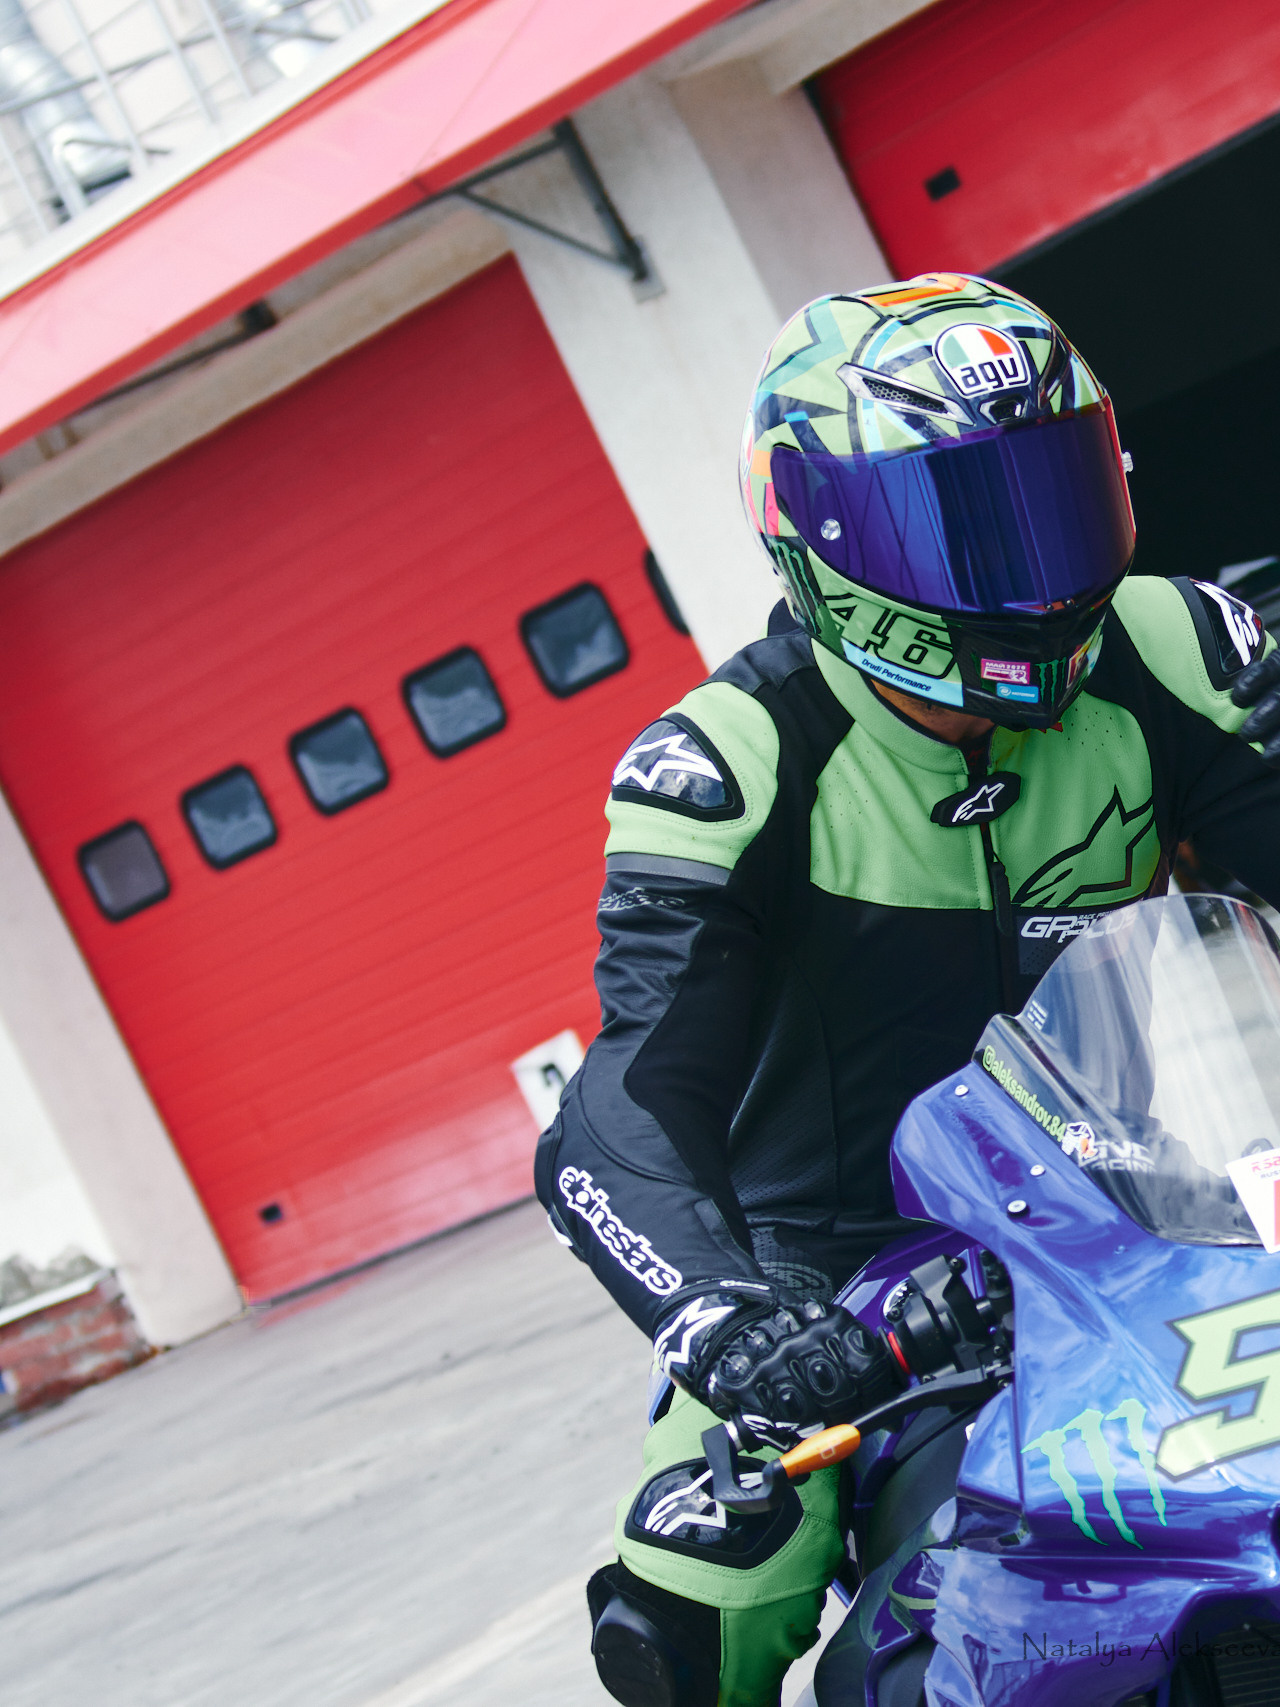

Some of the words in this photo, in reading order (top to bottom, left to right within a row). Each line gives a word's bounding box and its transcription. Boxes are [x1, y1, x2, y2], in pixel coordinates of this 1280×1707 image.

[959, 357, 1020, 390] agv
[861, 658, 883, 673] Drudi
[881, 667, 932, 692] Performance
[982, 1045, 1067, 1143] @aleksandrov.84
